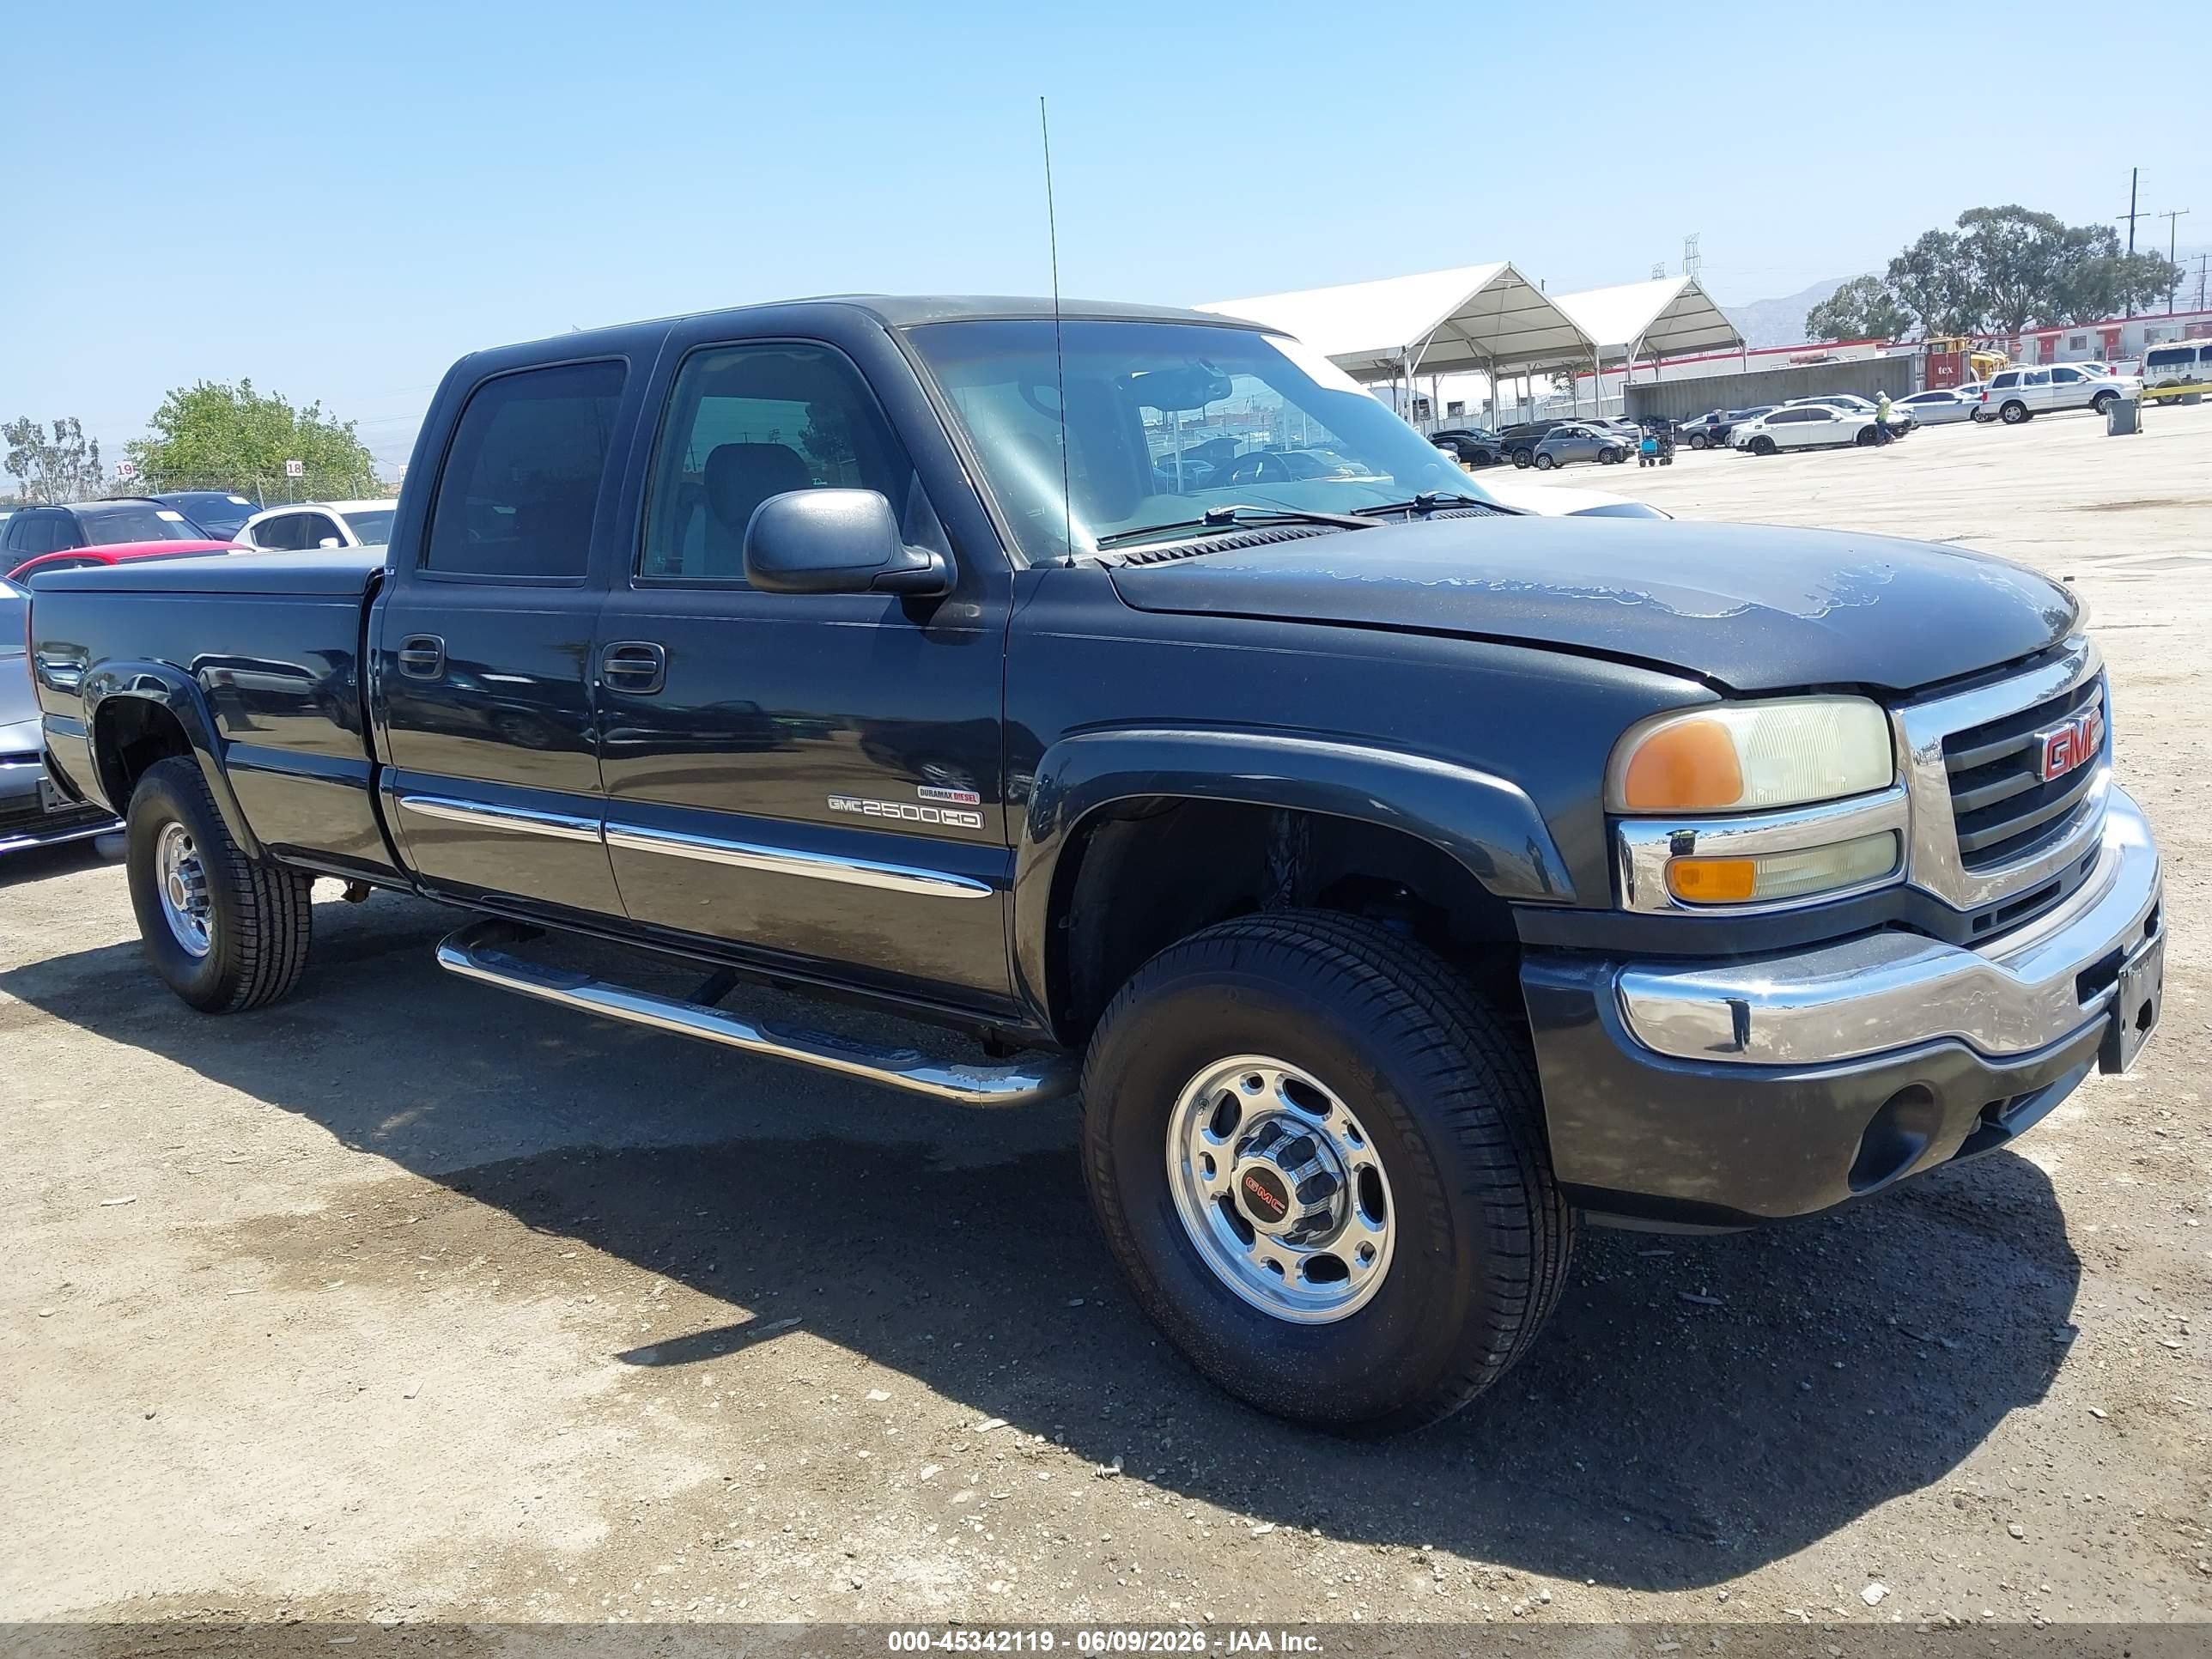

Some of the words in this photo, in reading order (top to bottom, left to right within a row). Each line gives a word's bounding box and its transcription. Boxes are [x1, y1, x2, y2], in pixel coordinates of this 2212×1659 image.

[1938, 365, 1954, 374] tex
[117, 465, 132, 475] 19
[288, 464, 301, 473] 18
[2043, 707, 2105, 782] GMC
[920, 788, 953, 799] DURAMAX
[954, 792, 977, 803] DIESEL
[1245, 1176, 1285, 1215] GMC
